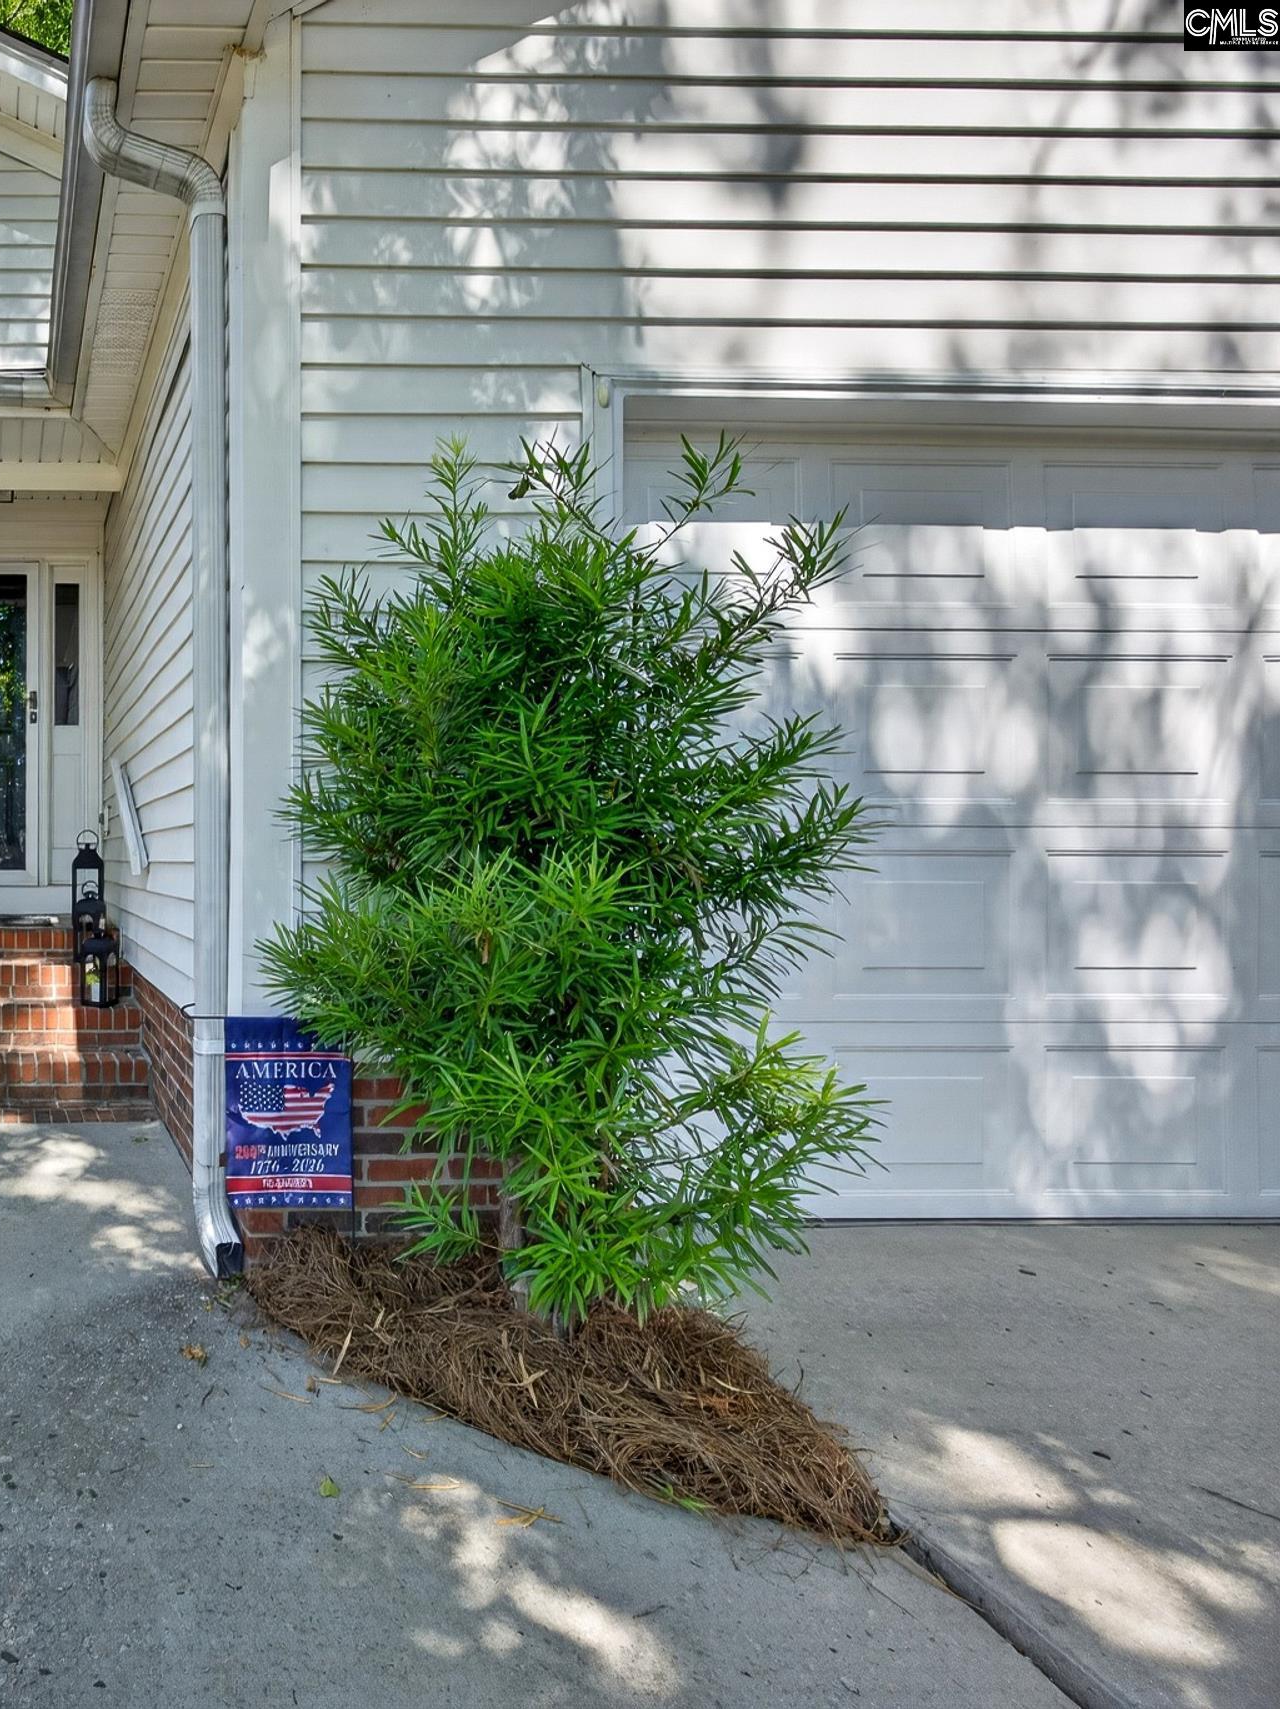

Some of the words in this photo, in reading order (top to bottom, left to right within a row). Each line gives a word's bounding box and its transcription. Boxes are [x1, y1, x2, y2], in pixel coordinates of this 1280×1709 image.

[235, 1061, 337, 1079] AMERICA
[268, 1143, 339, 1158] ANNIVERSARY
[250, 1160, 280, 1175] 1776
